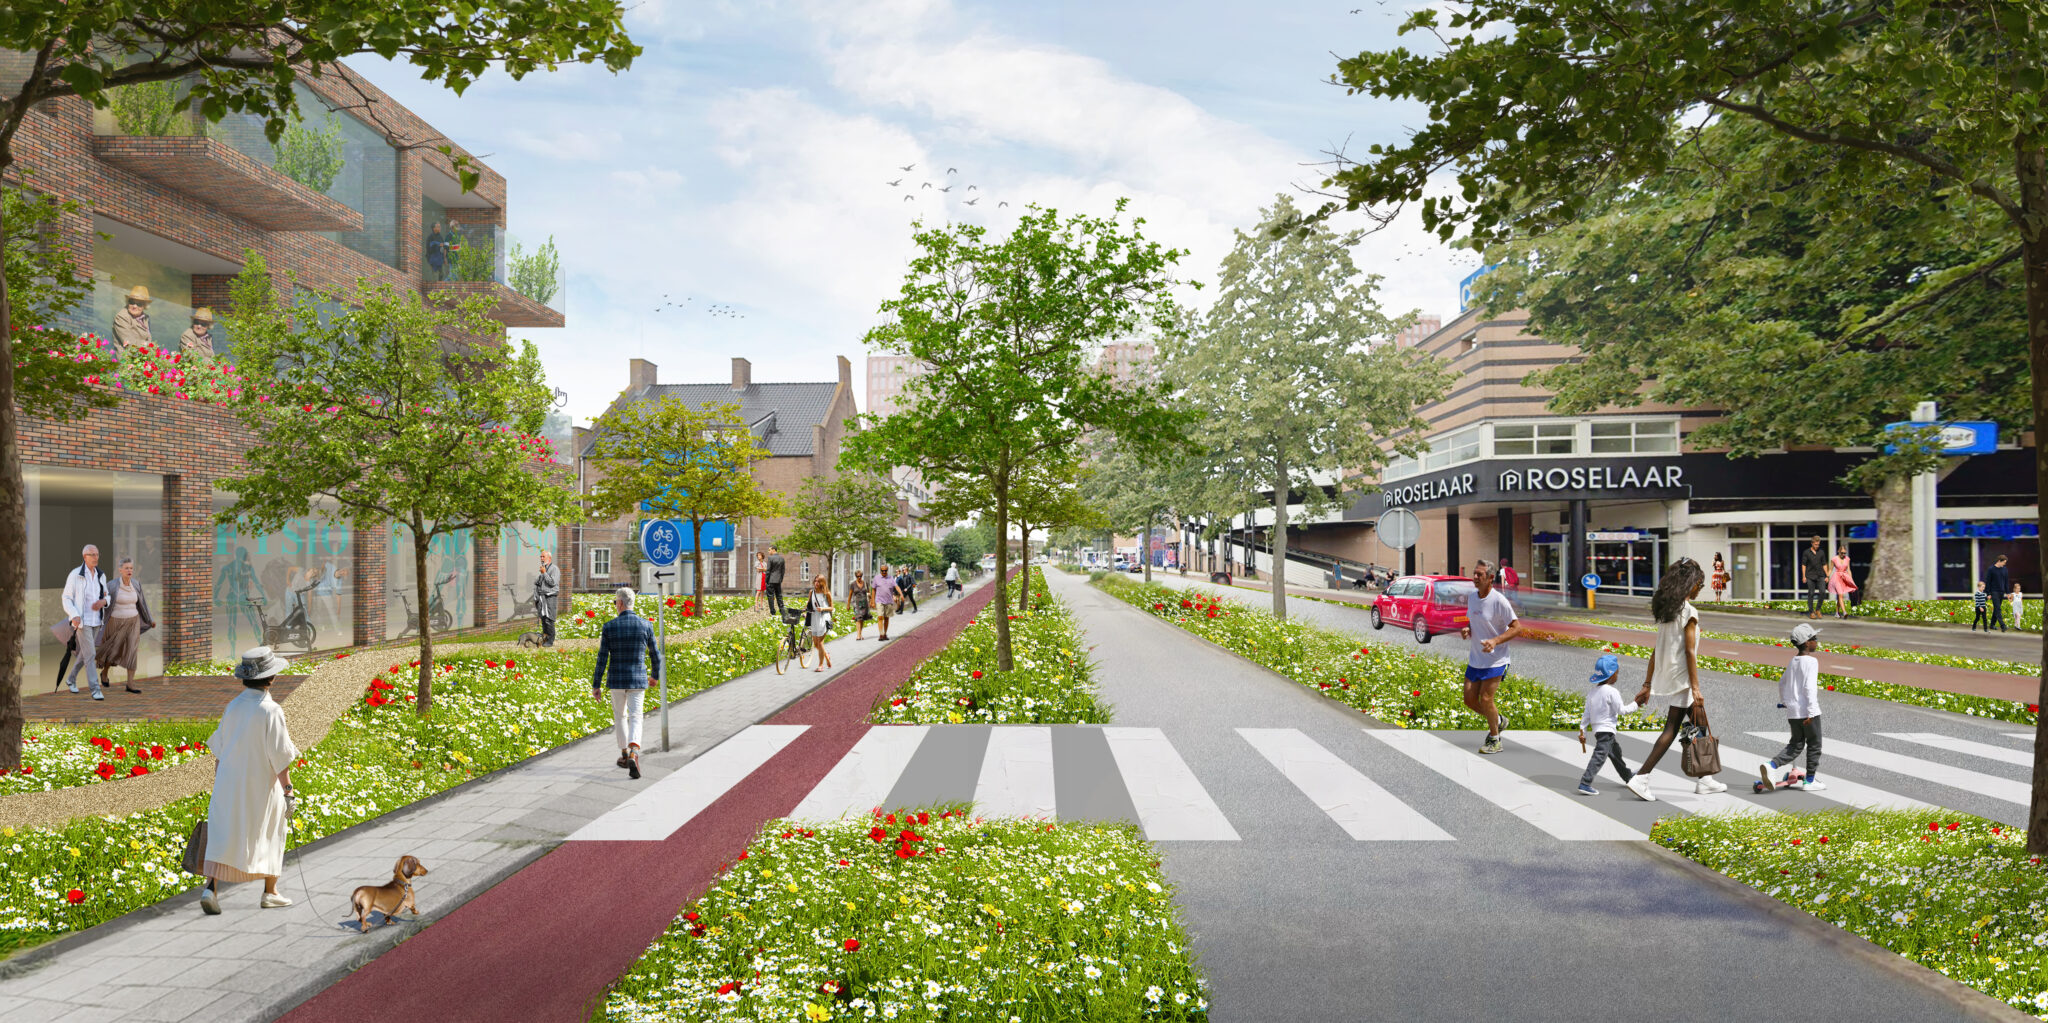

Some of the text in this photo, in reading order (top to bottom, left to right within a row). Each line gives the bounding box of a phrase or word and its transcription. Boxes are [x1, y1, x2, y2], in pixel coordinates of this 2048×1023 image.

[1393, 473, 1474, 506] ROSELAAR
[1526, 465, 1684, 491] ROSELAAR
[212, 515, 349, 556] FYSIO
